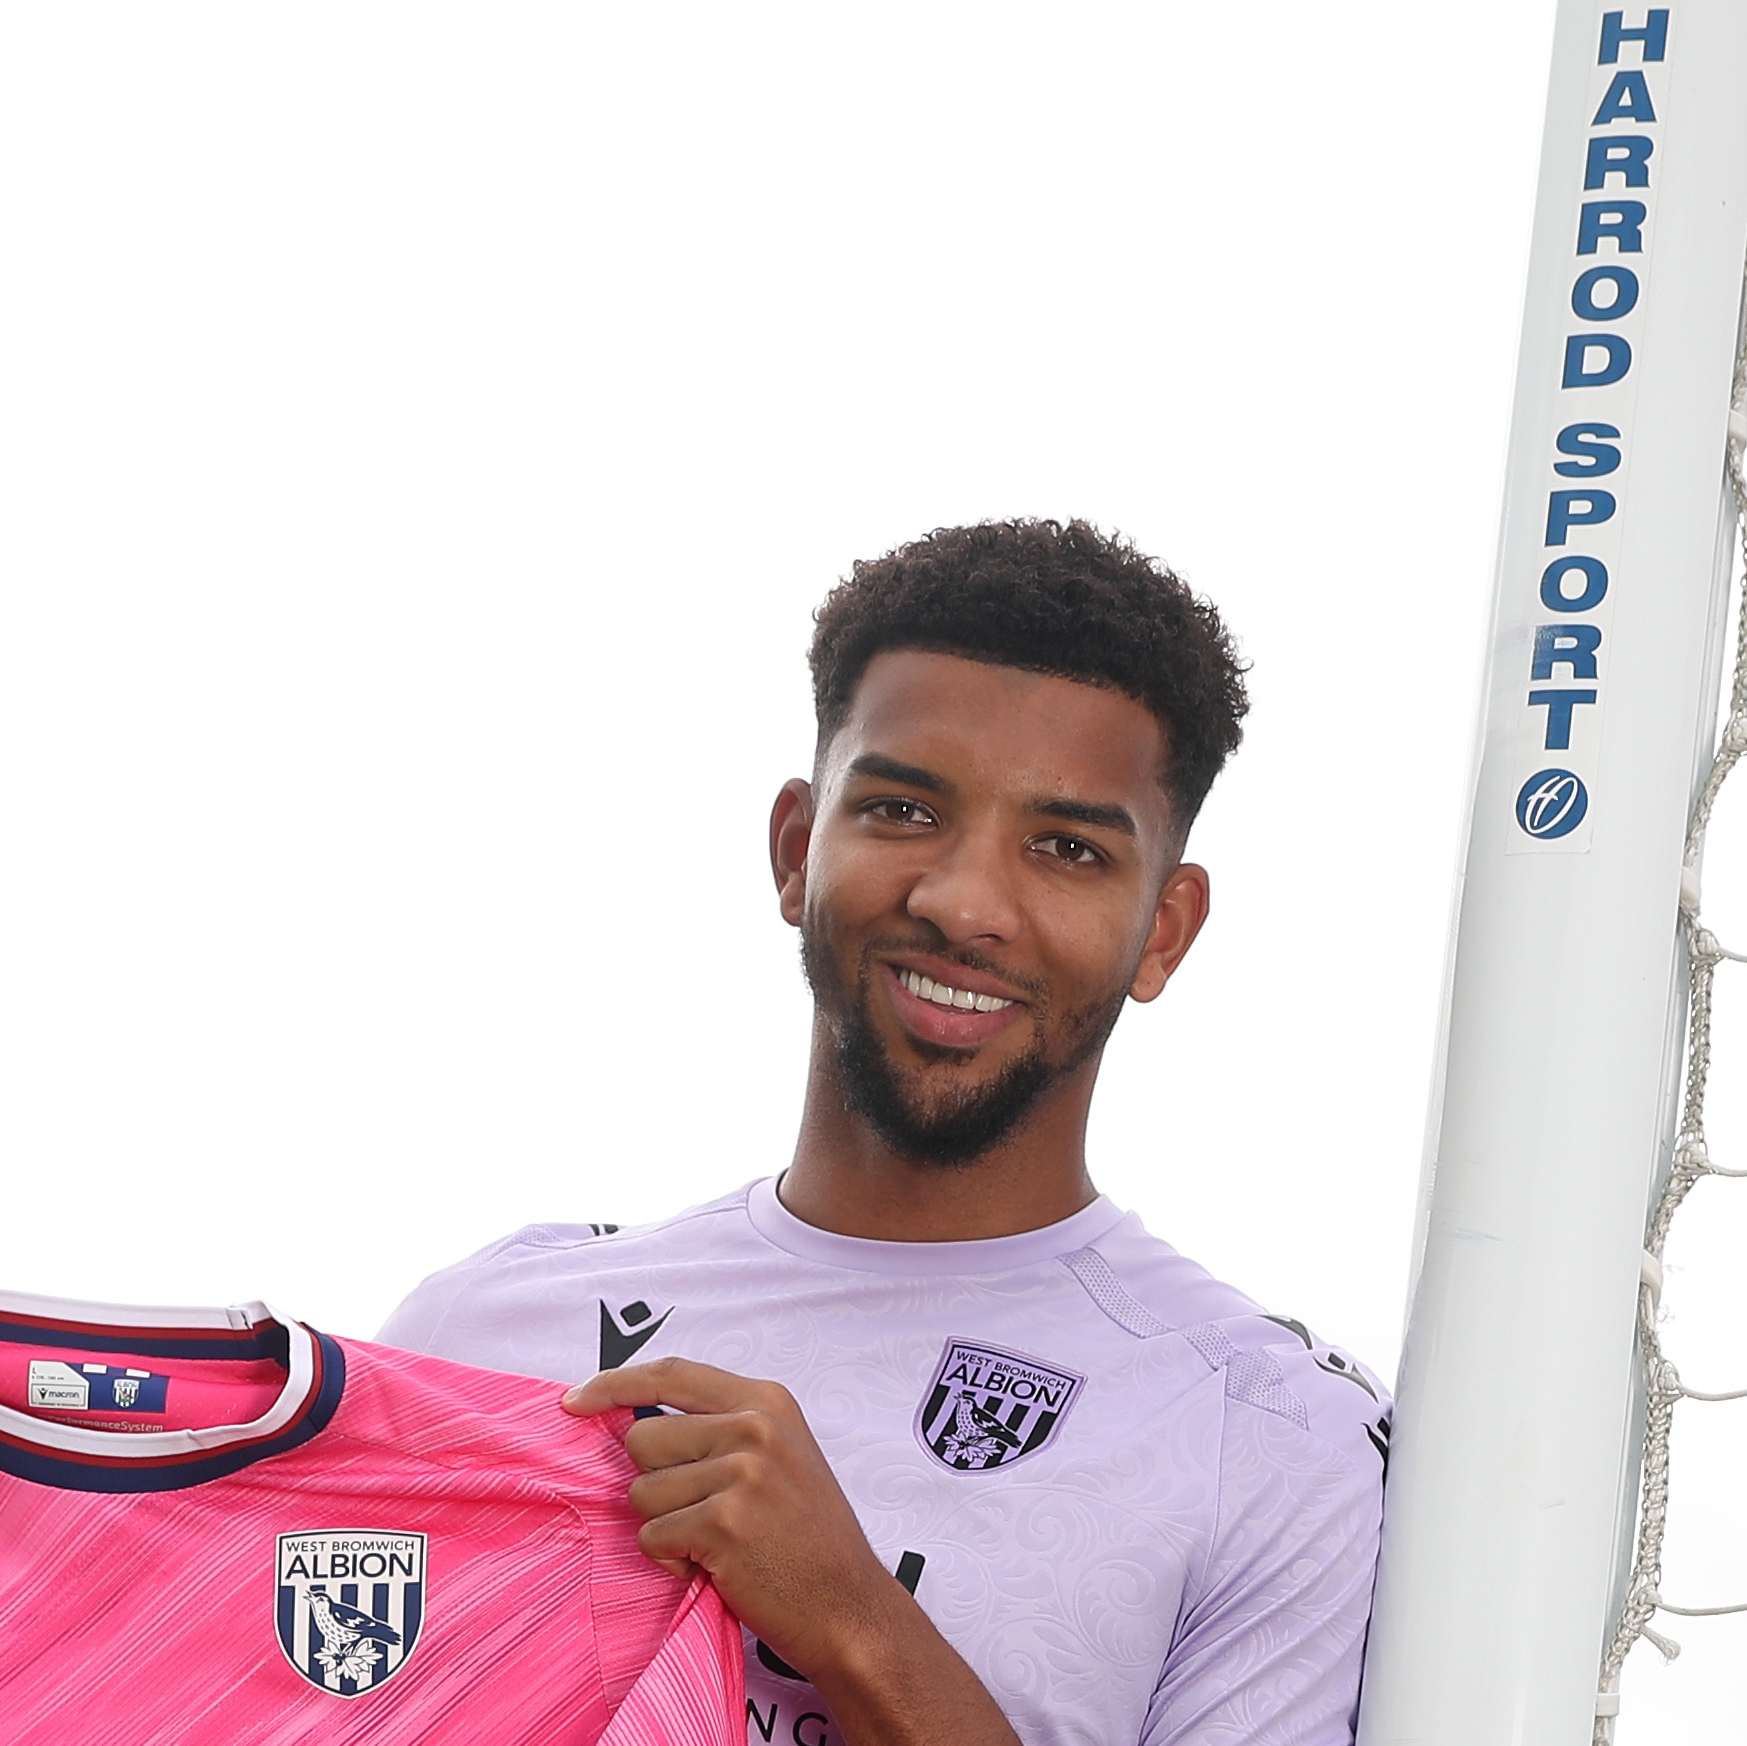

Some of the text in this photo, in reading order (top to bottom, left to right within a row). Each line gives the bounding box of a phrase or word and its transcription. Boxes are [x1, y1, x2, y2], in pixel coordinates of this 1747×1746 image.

[1526, 9, 1669, 751] HARROD SPORT
[946, 1363, 1062, 1407] ALBION
[955, 1351, 1067, 1391] WEST BROMWICH
[285, 1552, 414, 1580] ALBION
[286, 1540, 415, 1552] WEST BROMWICH
